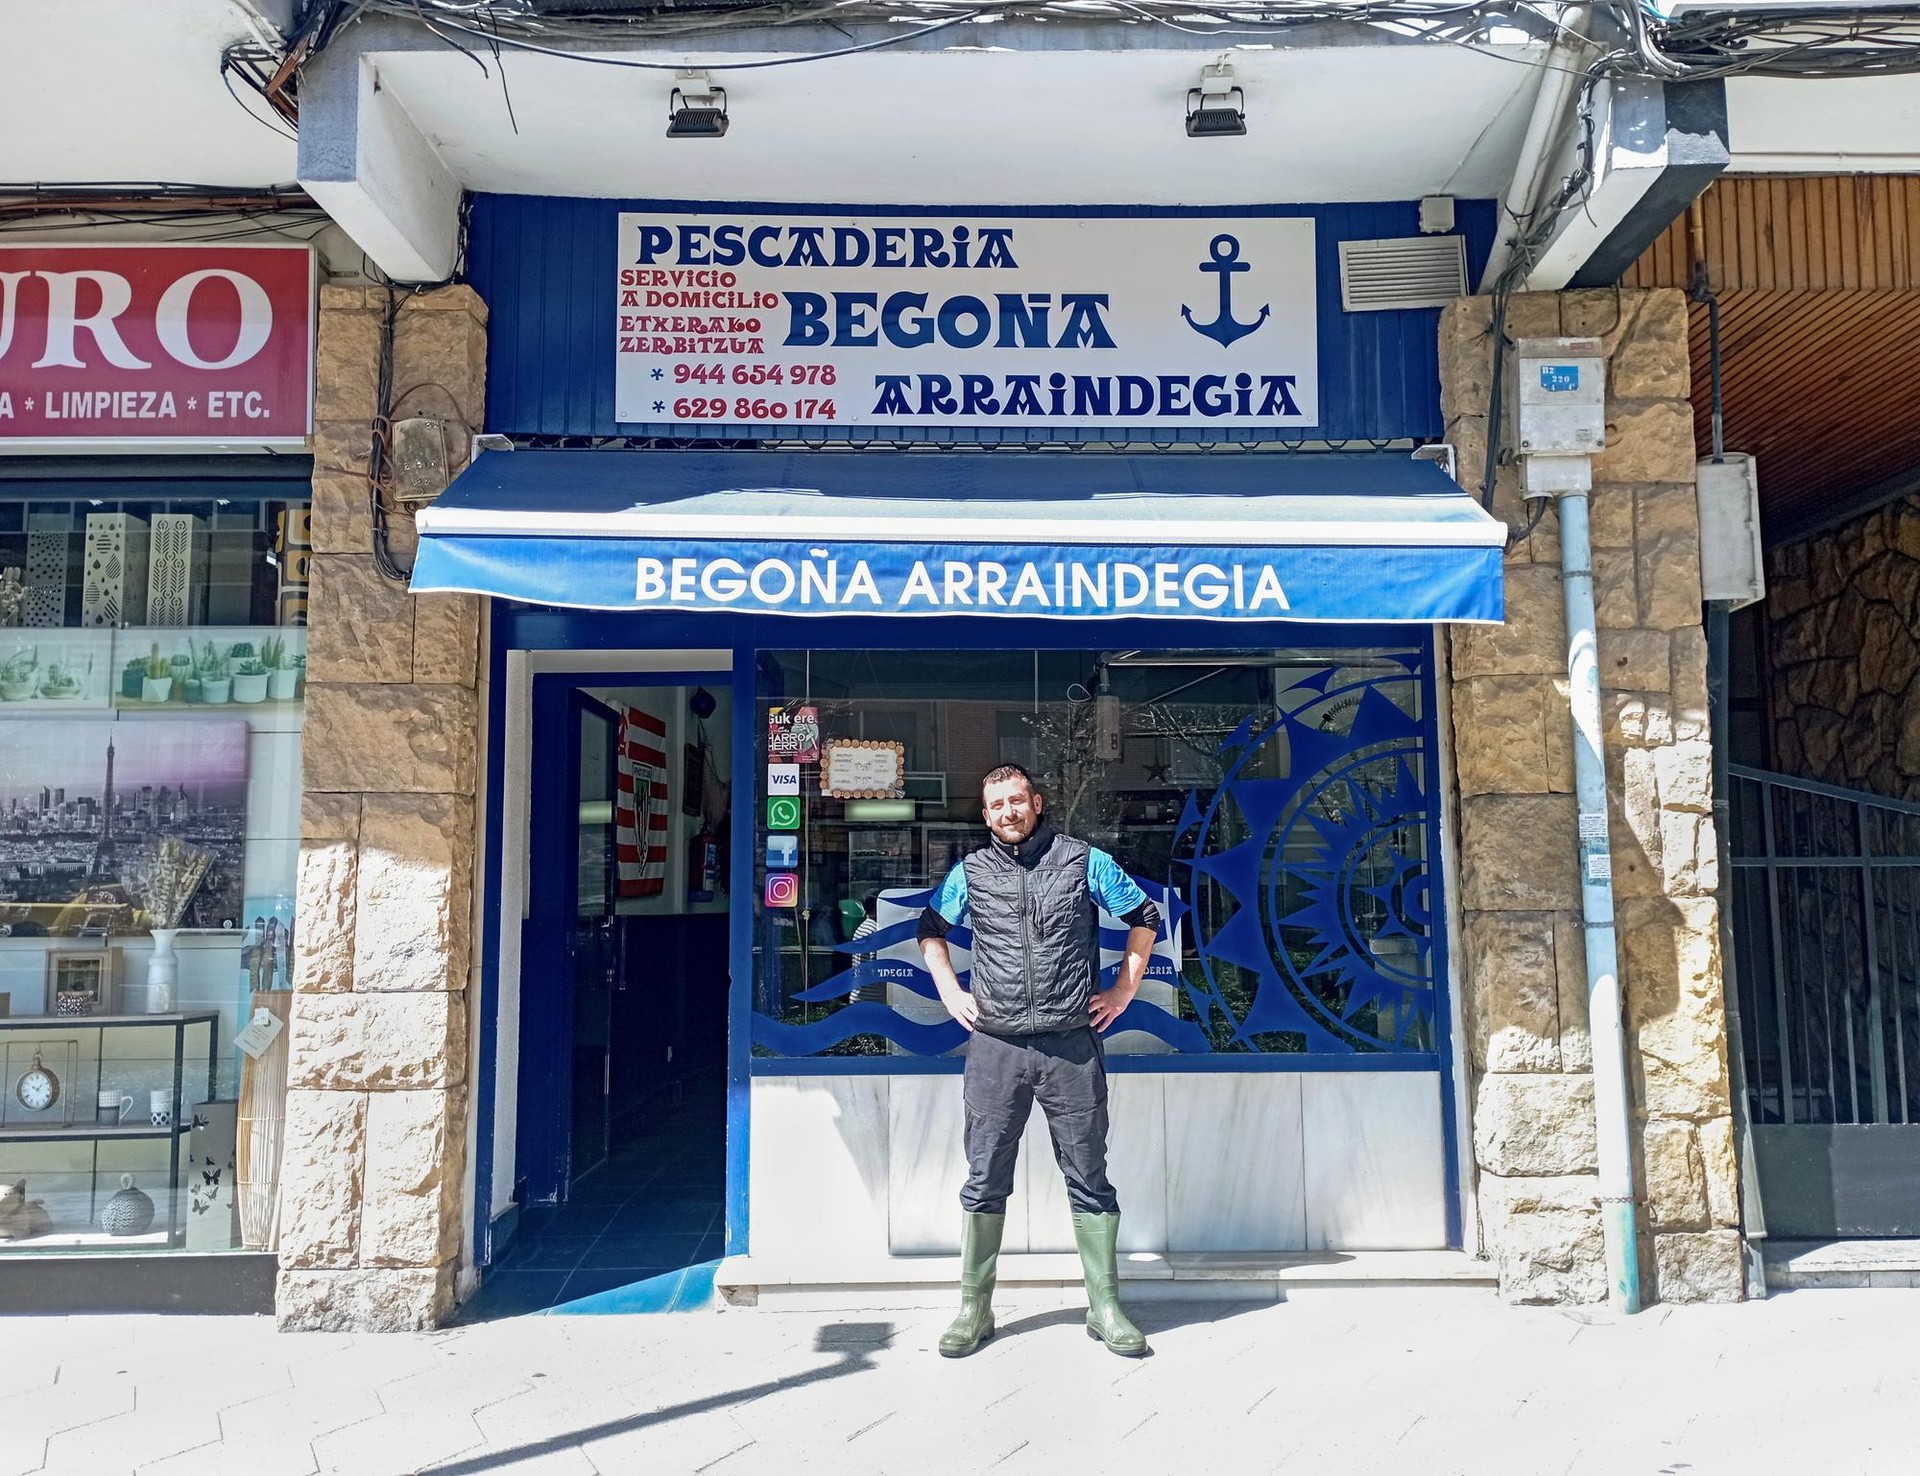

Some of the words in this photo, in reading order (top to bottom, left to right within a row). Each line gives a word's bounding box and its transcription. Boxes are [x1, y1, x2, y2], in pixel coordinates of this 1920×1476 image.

[621, 291, 639, 307] A
[619, 315, 762, 334] ETXERAKO
[781, 291, 1118, 349] BEGOÑA
[673, 363, 726, 385] 944
[731, 364, 784, 386] 654
[789, 365, 836, 386] 978
[45, 391, 177, 418] LIMPIEZA
[207, 391, 270, 418] ETC.
[673, 397, 727, 419] 629
[733, 398, 788, 420] 860
[794, 398, 836, 420] 174
[635, 548, 883, 606] BEGOÑA
[897, 560, 1291, 611] ARRAINDEGIA
[772, 775, 797, 784] VISA
